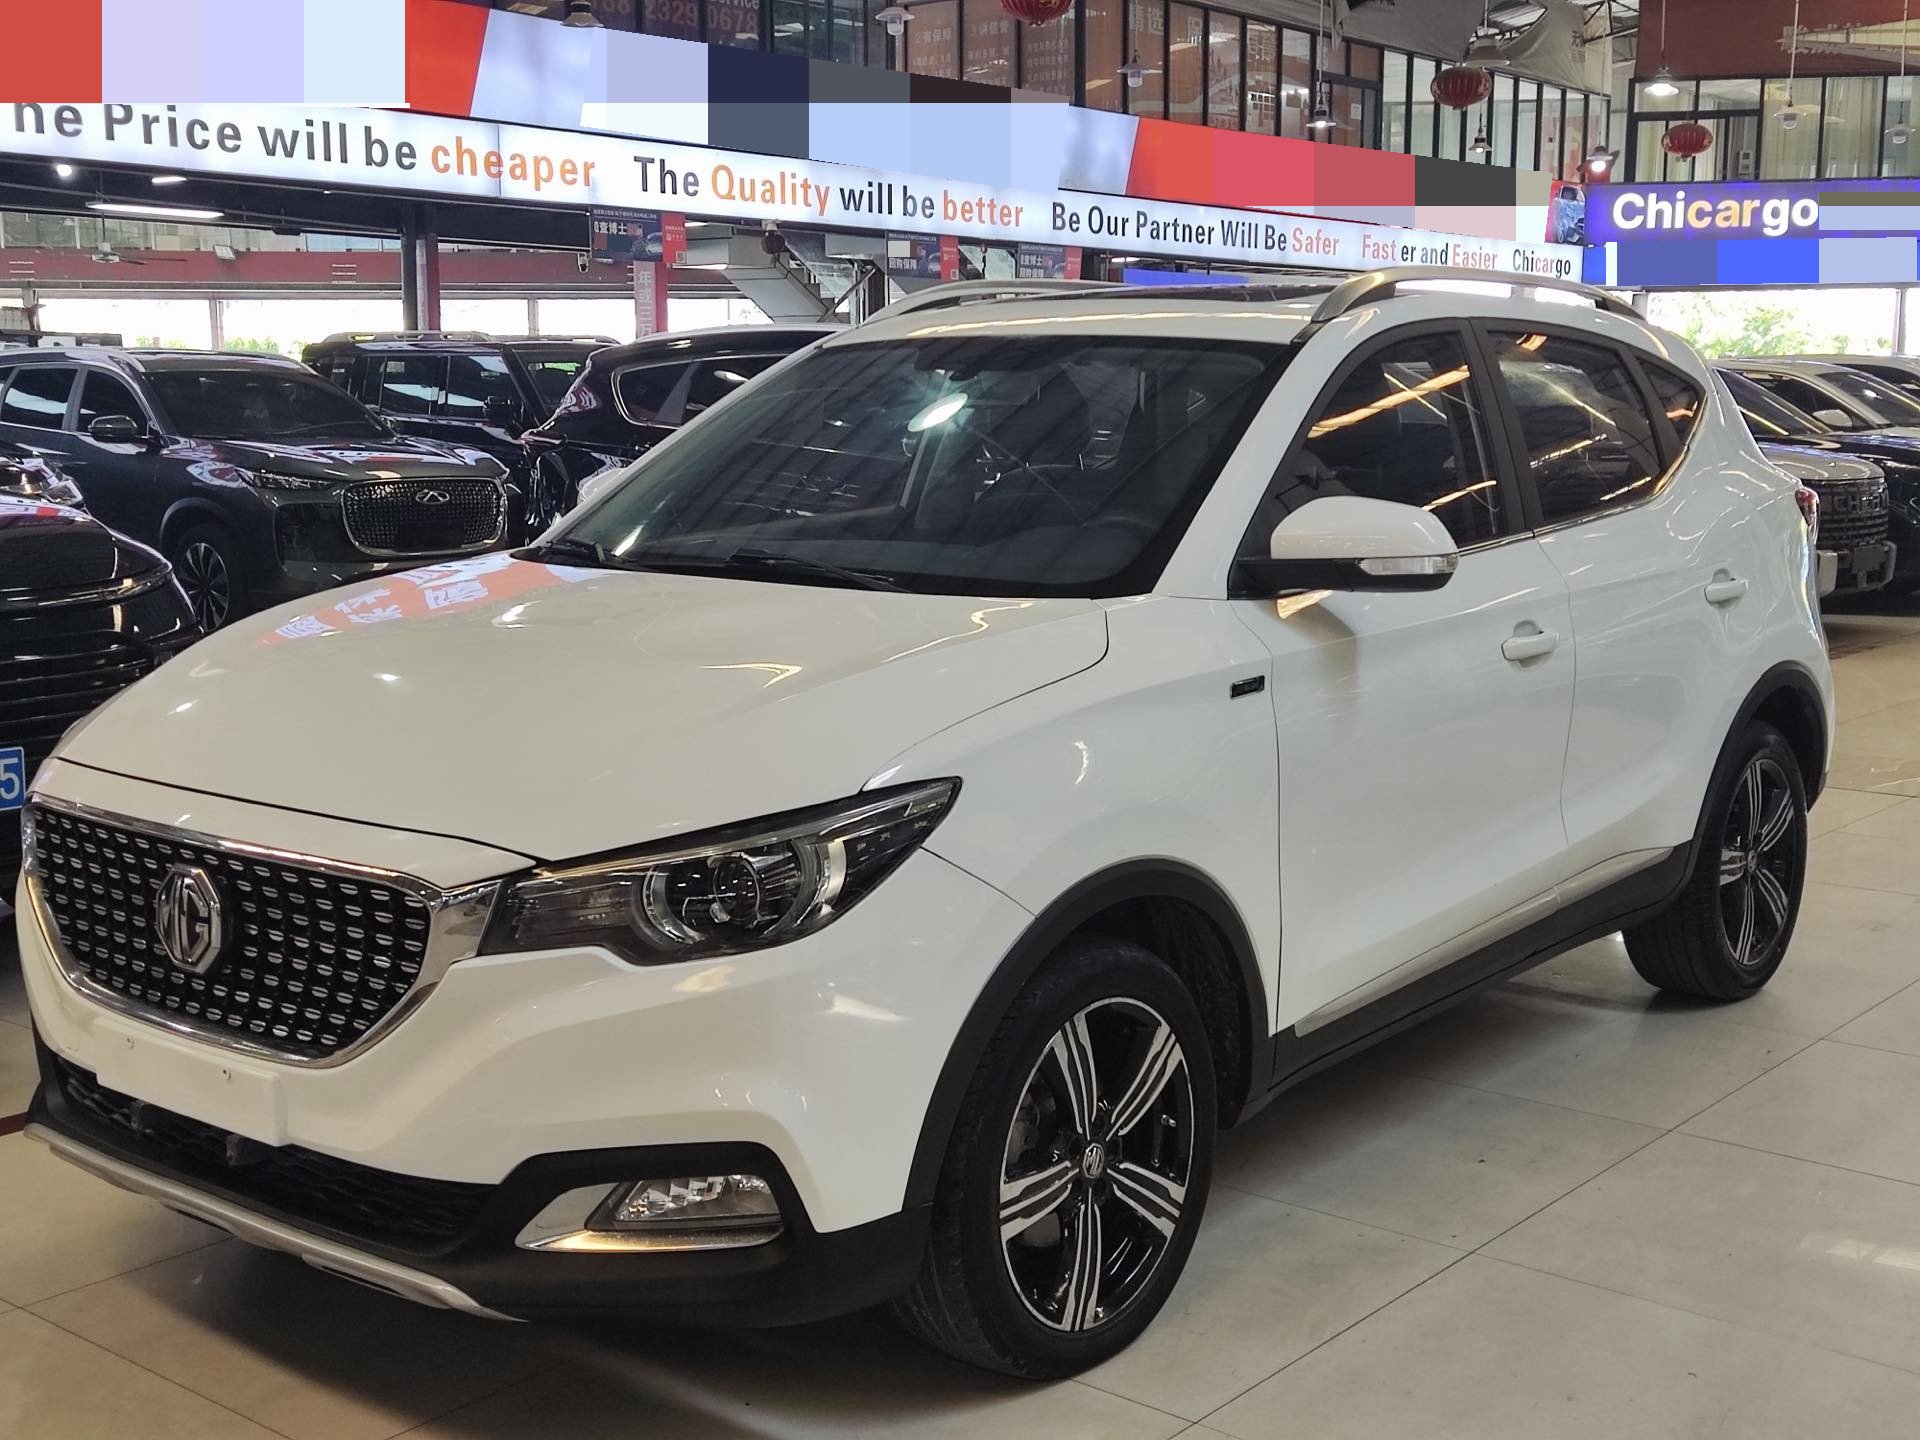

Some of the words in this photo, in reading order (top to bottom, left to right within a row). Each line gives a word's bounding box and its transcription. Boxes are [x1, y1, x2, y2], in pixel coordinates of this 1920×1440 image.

[708, 7, 758, 33] 0678
[104, 103, 242, 153] Price
[257, 119, 348, 163] will
[364, 126, 417, 170] be
[430, 136, 596, 191] cheaper
[633, 156, 699, 197] The
[711, 165, 830, 216] Quality
[839, 182, 894, 216] will
[902, 185, 934, 219] be
[943, 190, 1024, 228] better
[1613, 191, 1819, 237] Chicargo
[1052, 201, 1081, 232] Be
[1088, 205, 1129, 237] Our
[1136, 210, 1214, 245] Partner
[1221, 219, 1258, 249] Will
[1265, 225, 1287, 251] Be
[1292, 227, 1339, 256] Safer
[1420, 243, 1448, 265] and
[1452, 244, 1498, 269] Easier
[1512, 248, 1571, 278] Chicargo
